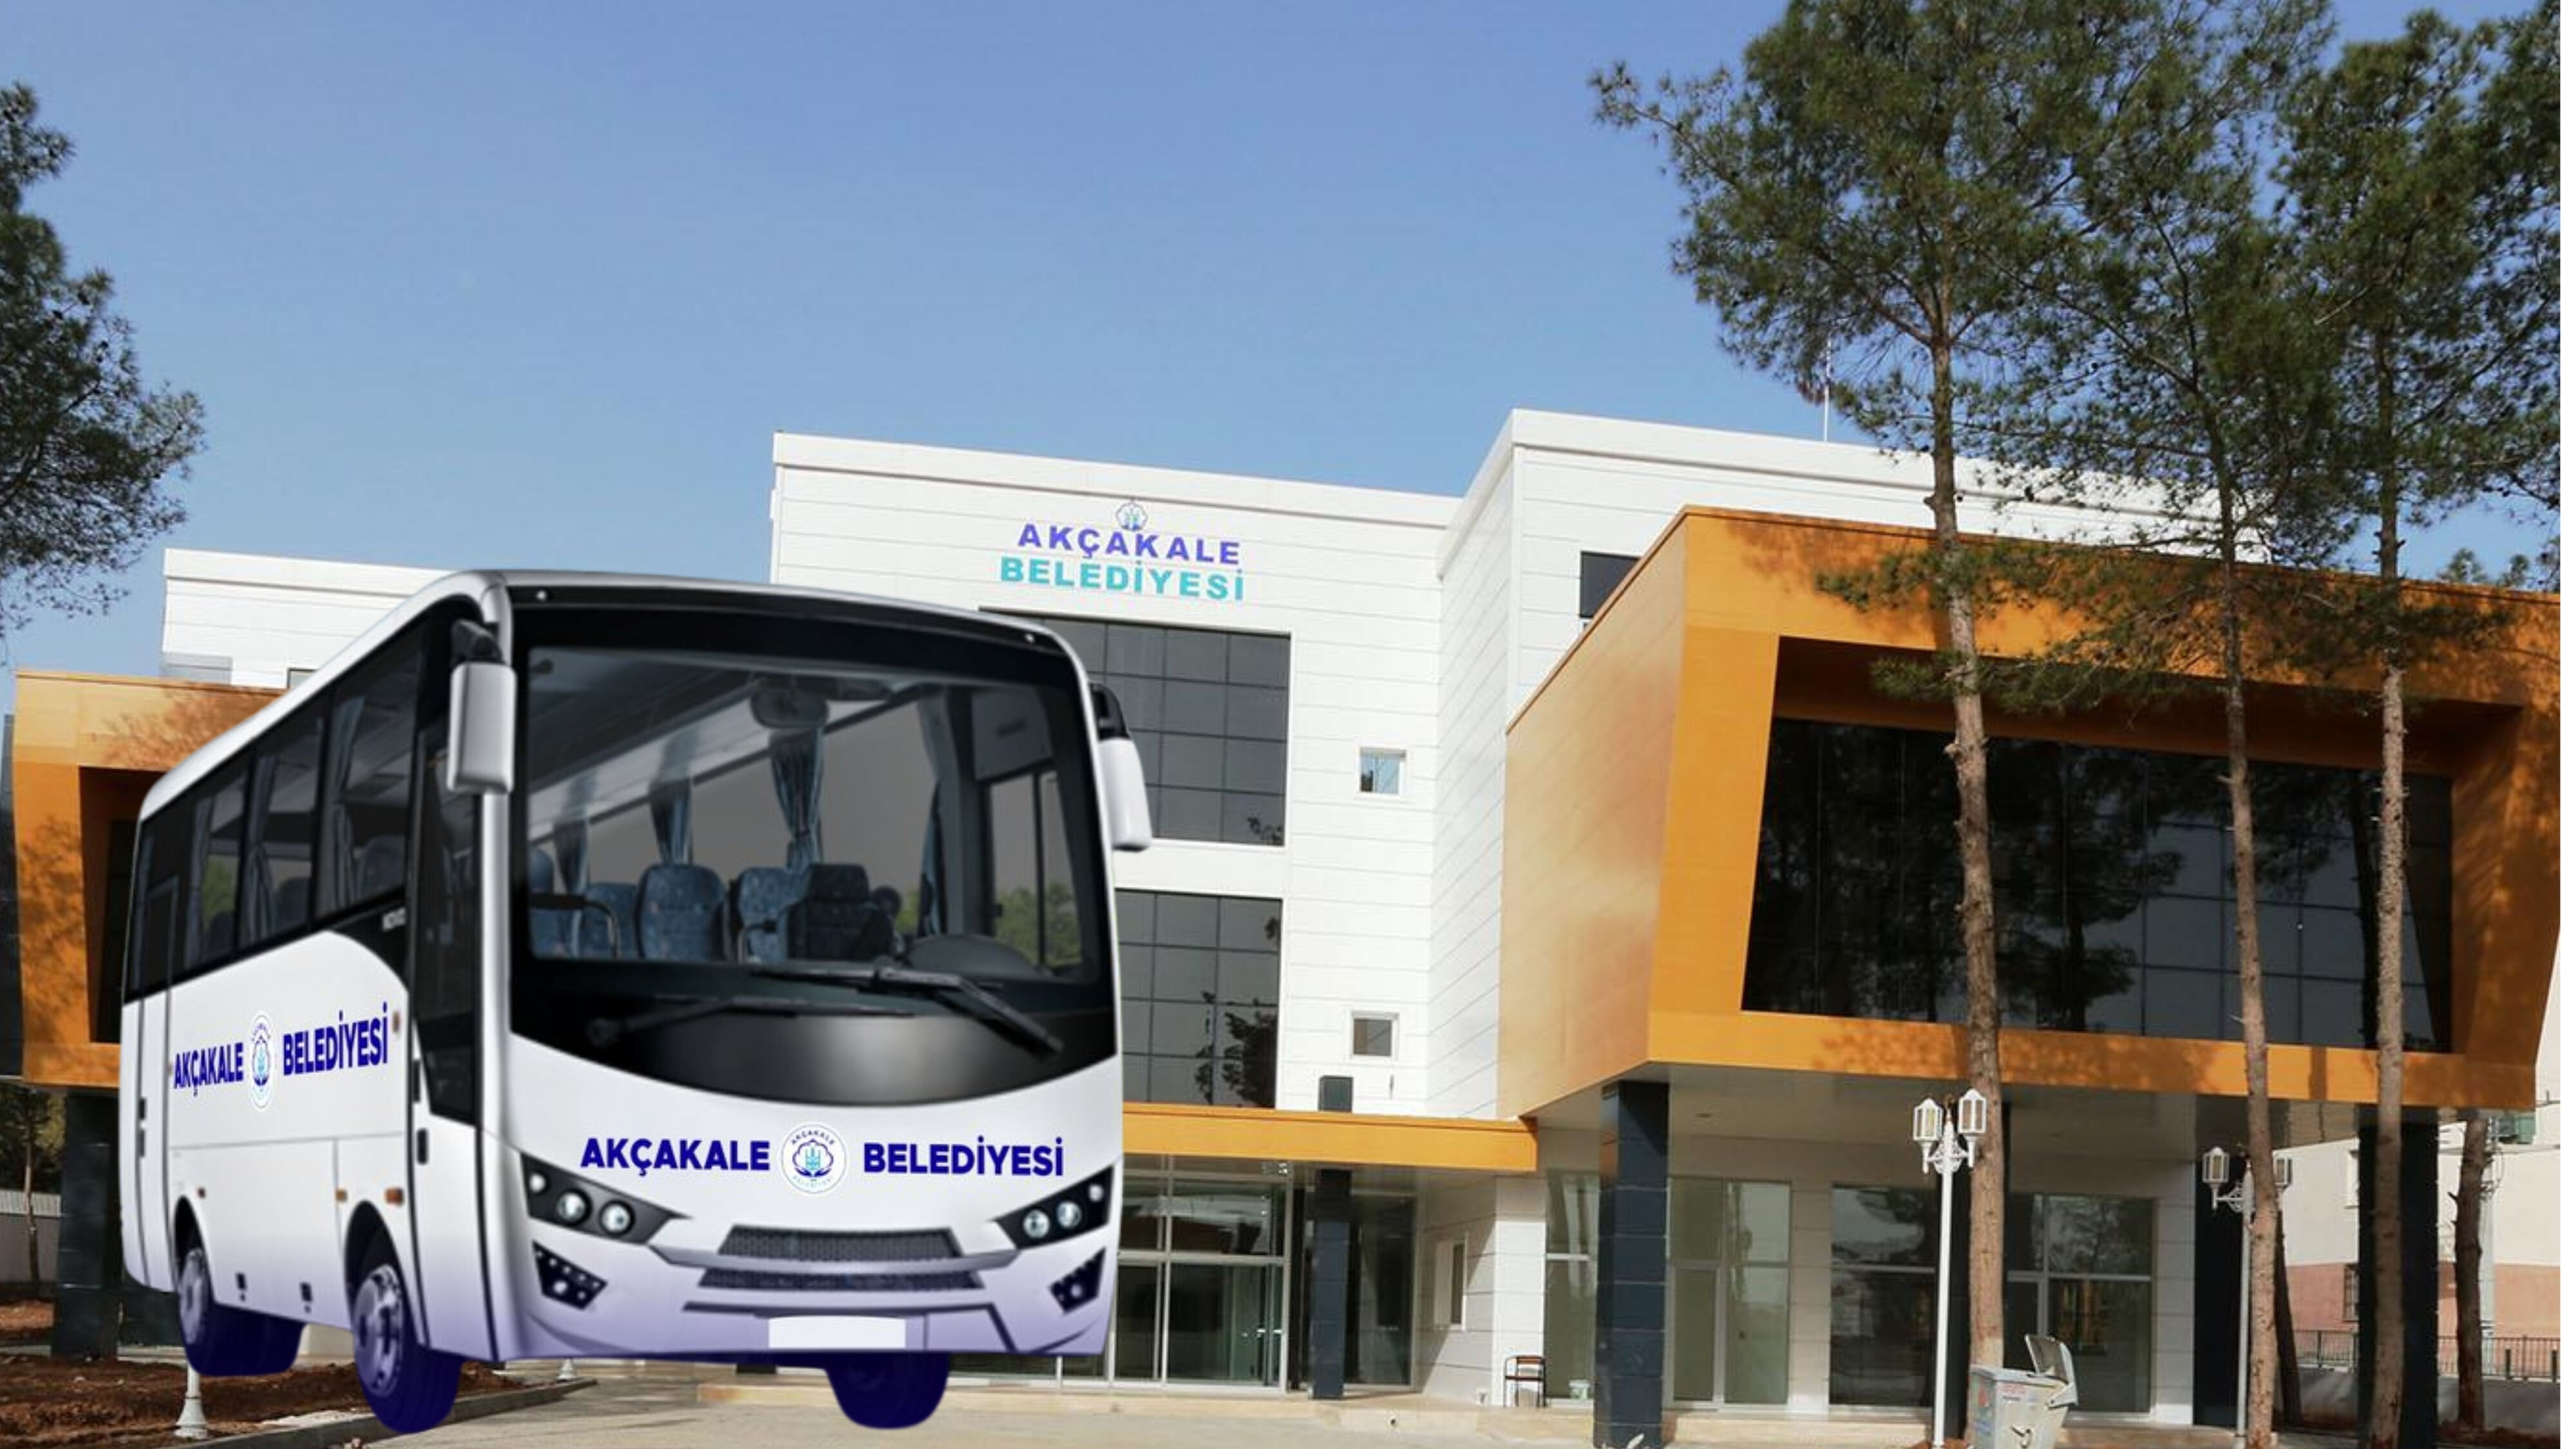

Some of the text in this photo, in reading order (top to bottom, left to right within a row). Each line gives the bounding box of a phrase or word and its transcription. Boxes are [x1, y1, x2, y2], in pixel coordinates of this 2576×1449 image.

[1018, 523, 1240, 565] AKÇAKALE
[1000, 555, 1244, 601] BELEDİYESİ
[174, 1001, 388, 1096] AKÇAKALE BELEDİYESİ
[580, 1135, 1063, 1176] AKÇAKALE BELEDİYESİ
